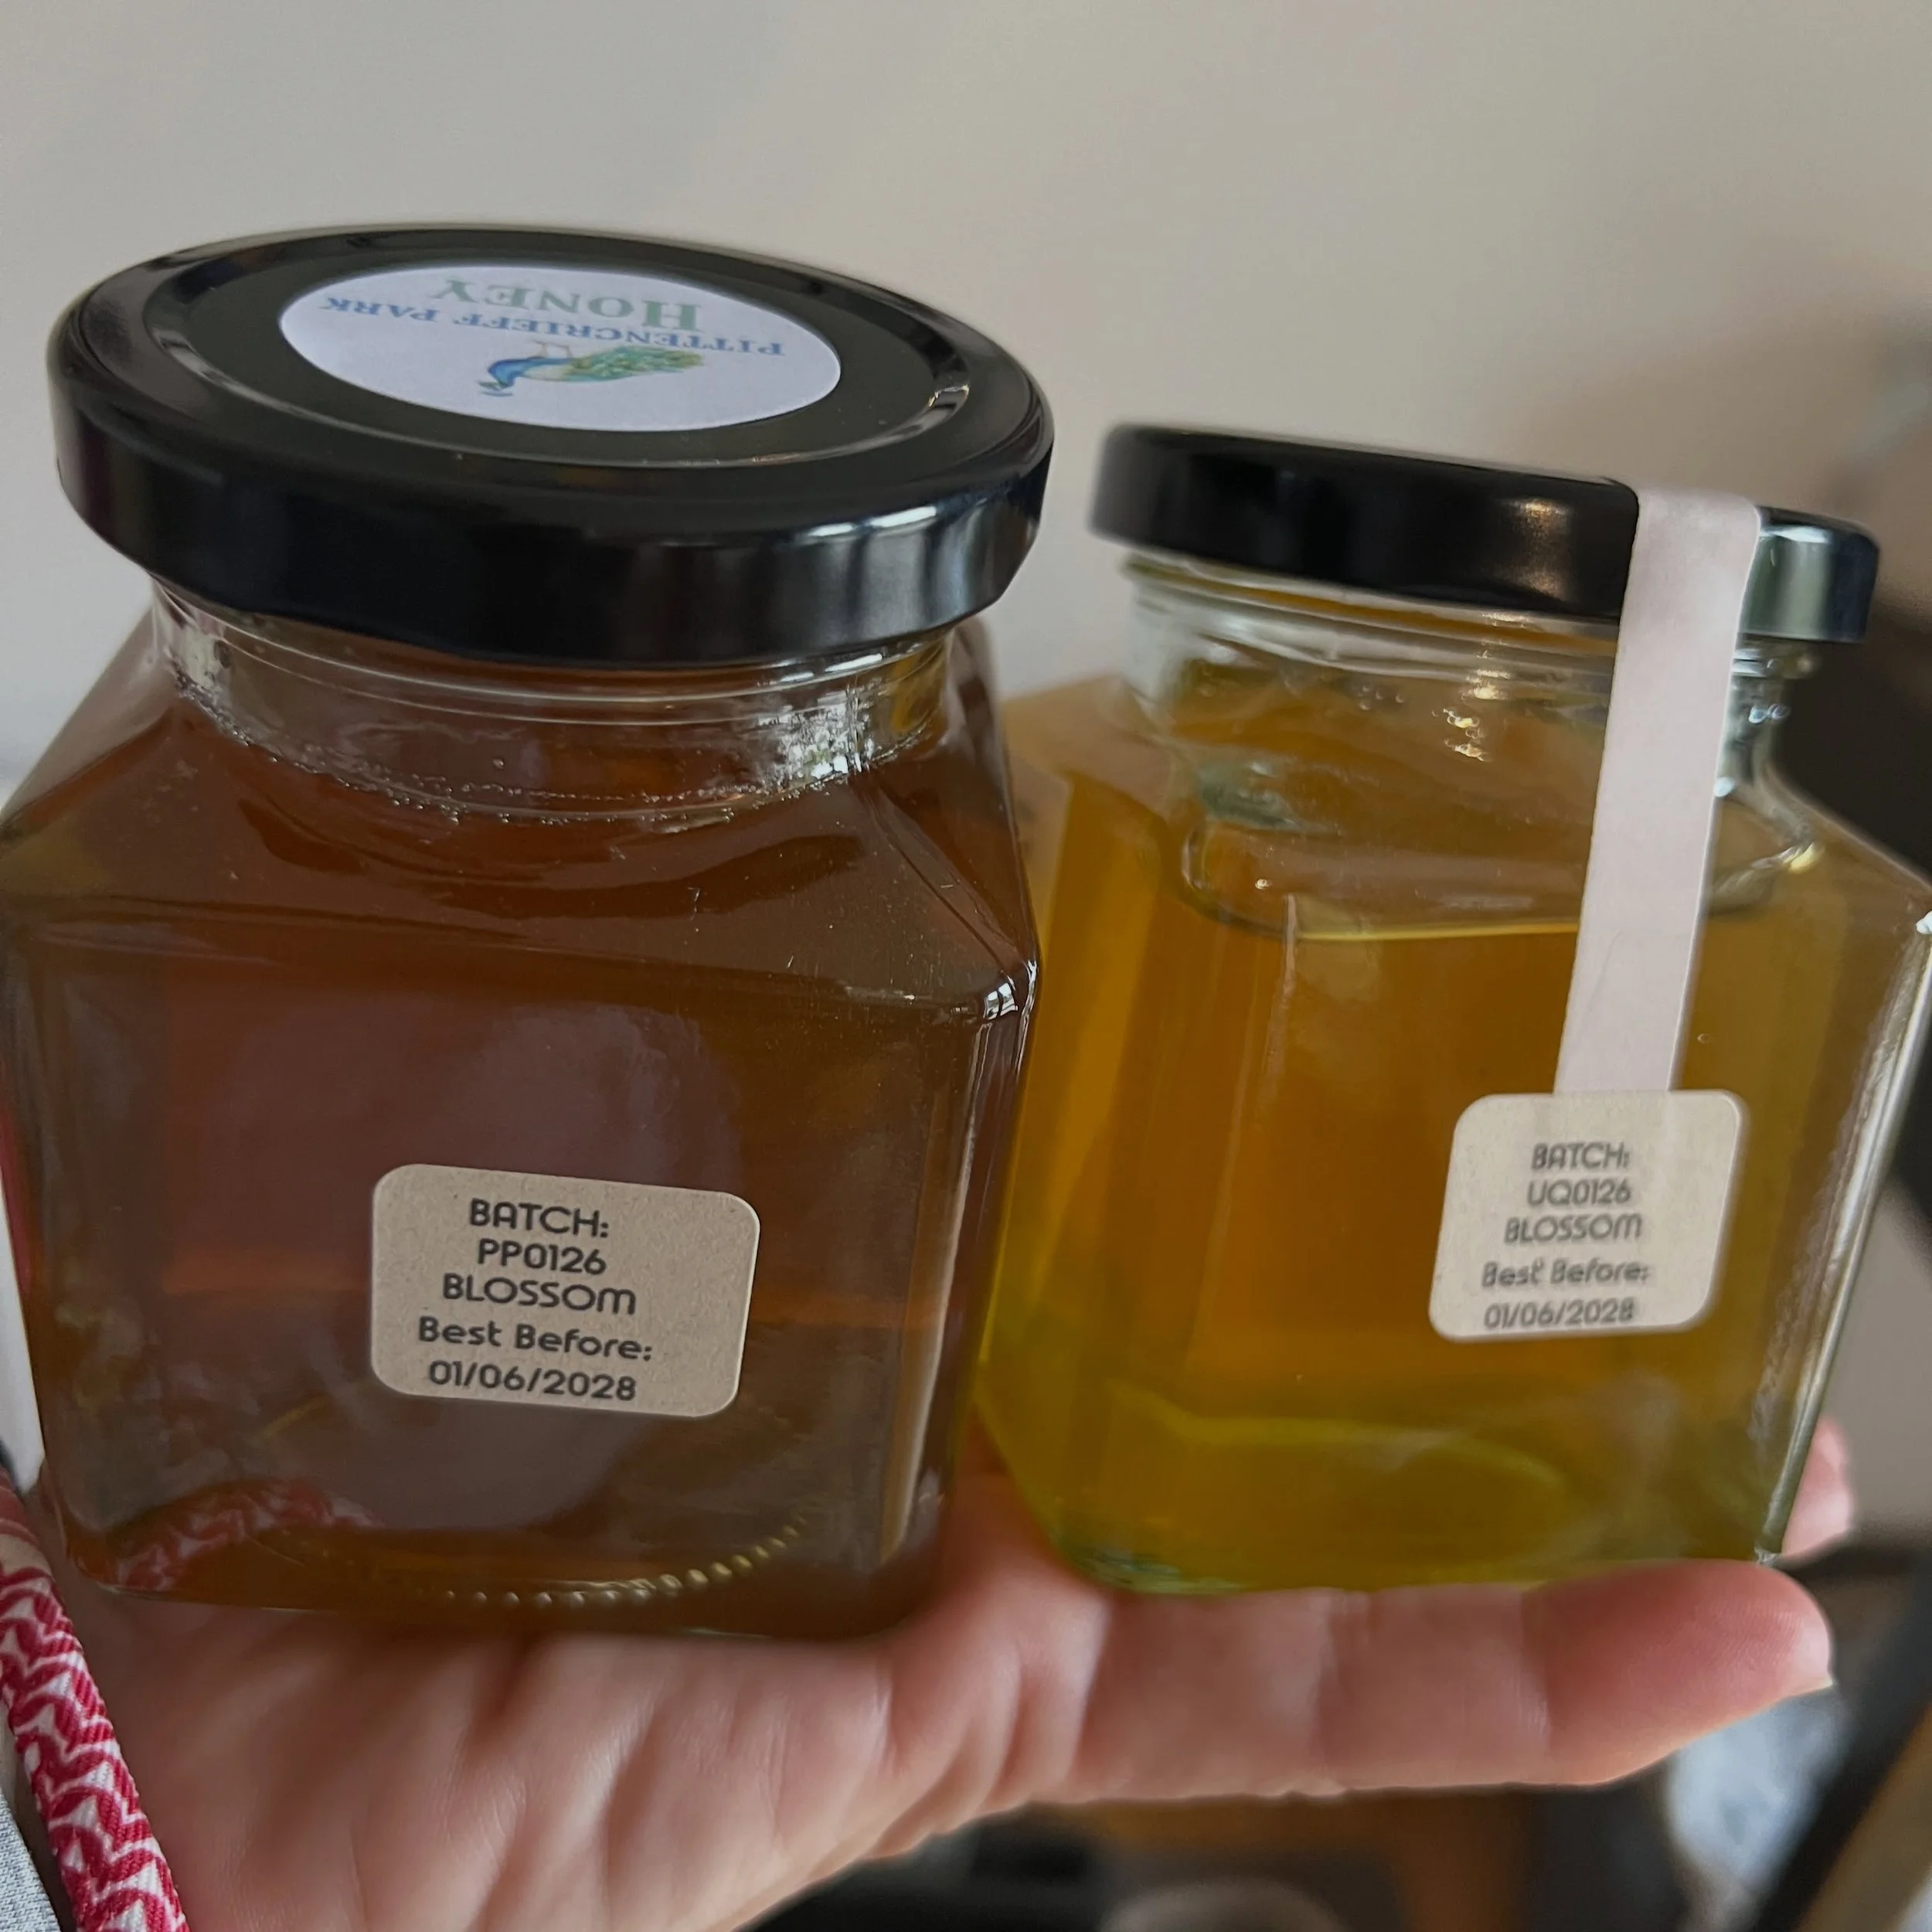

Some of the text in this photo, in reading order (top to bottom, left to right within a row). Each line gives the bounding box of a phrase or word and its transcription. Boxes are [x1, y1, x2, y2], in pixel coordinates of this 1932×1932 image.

[432, 278, 702, 333] HONEY
[319, 296, 785, 356] PITTENCRIEFF PARK
[1531, 1143, 1631, 1170] BATCH:
[1527, 1178, 1631, 1206] UQ0126
[468, 1198, 609, 1239] BATCH:
[1504, 1213, 1642, 1243] BLOSSOM
[478, 1238, 607, 1275] PP0126
[1481, 1257, 1649, 1287] Best Before:
[442, 1273, 637, 1315] BLOSSOM
[1484, 1297, 1635, 1330] 01/06/2028
[418, 1315, 653, 1362] Best Before:
[428, 1359, 637, 1402] 01/06/2028
